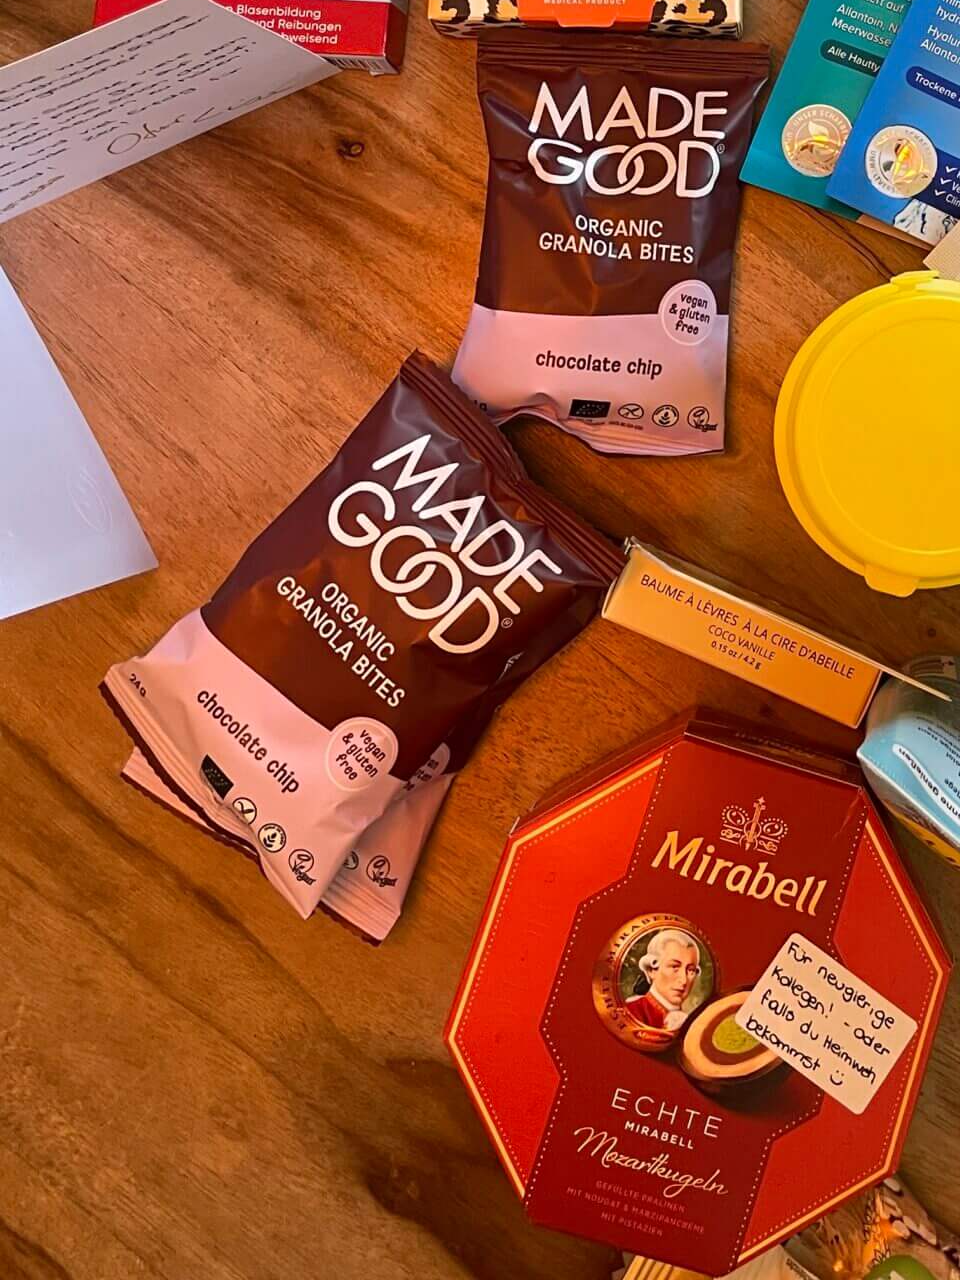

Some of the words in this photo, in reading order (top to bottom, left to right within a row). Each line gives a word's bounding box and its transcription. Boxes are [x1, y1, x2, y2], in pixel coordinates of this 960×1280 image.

[236, 4, 321, 20] Blasenbildung
[278, 19, 342, 33] Reibungen
[827, 45, 847, 59] Alle
[915, 72, 957, 100] Trockene
[528, 81, 729, 141] MADE
[527, 138, 720, 198] GOOD
[575, 215, 664, 238] ORGANIC
[539, 232, 632, 260] GRANOLA
[639, 240, 694, 264] BITES
[678, 304, 711, 324] gluten
[680, 293, 708, 309] vegan
[675, 320, 699, 336] free
[536, 350, 622, 374] chocolate
[626, 354, 663, 377] chip
[372, 433, 562, 616] MADE
[327, 479, 501, 655] GOOD
[321, 581, 396, 663] ORGANIC
[641, 574, 685, 602] BAUME
[697, 599, 739, 626] LÈVRES
[754, 625, 768, 640] LA
[770, 633, 797, 653] CIRE
[799, 645, 855, 679] D'ABEILLE
[276, 575, 350, 662] GRANOLA
[351, 657, 407, 709] BITES
[709, 624, 736, 643] COCO
[738, 635, 776, 661] VANILLE
[711, 640, 727, 653] 0.15
[197, 690, 267, 760] chocolate
[267, 760, 299, 793] chip
[360, 730, 386, 762] vegan
[336, 753, 358, 781] free
[346, 744, 378, 778] gluten
[651, 830, 828, 917] Mirabell
[788, 942, 812, 964] Für
[817, 966, 895, 1029] neugierige
[771, 965, 834, 1019] Kollegen!
[854, 1028, 890, 1055] oder
[746, 1014, 821, 1071] bekommst
[761, 989, 795, 1021] falls
[800, 1021, 819, 1040] du
[823, 1035, 877, 1085] Heimweh
[610, 1087, 723, 1138] ECHTE
[624, 1120, 694, 1150] MIRABELL
[573, 1126, 729, 1199] Mozartkugeln
